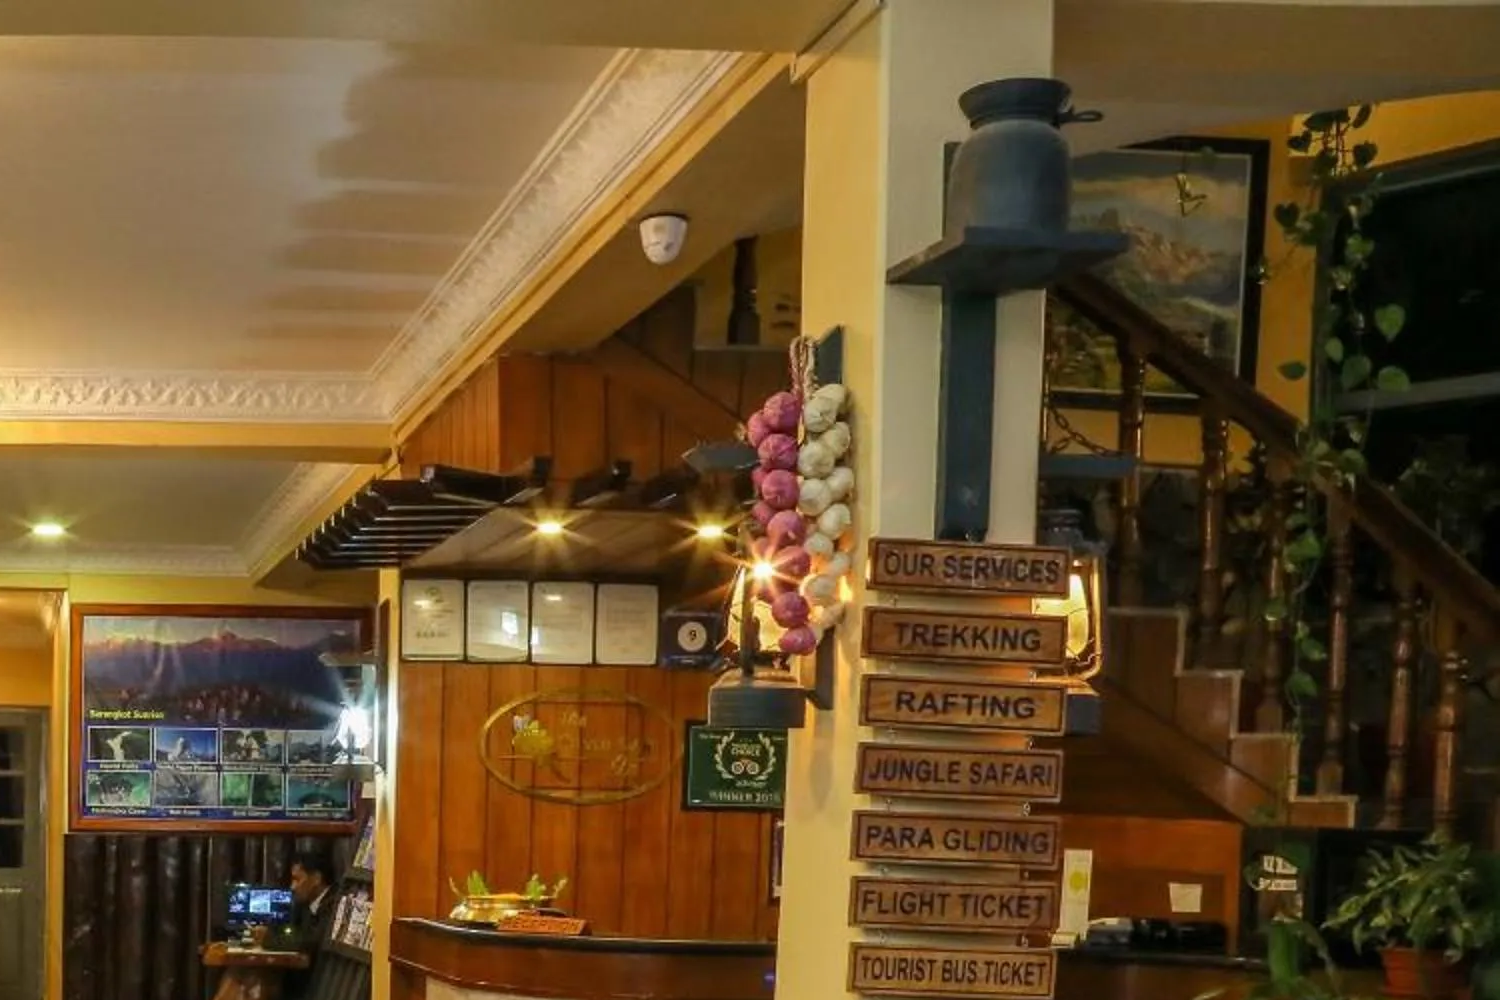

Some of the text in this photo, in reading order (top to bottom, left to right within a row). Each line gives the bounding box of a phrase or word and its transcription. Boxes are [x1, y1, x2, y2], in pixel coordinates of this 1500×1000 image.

[884, 552, 1060, 583] OUR SERVICES
[893, 622, 1041, 651] TREKKING
[896, 690, 1035, 719] RAFTING
[869, 758, 1053, 787] JUNGLE SAFARI
[866, 826, 1049, 853] PARA GLIDING
[861, 890, 1048, 919] FLIGHT TICKET
[861, 956, 1047, 987] TOURIST BUS TICKET
